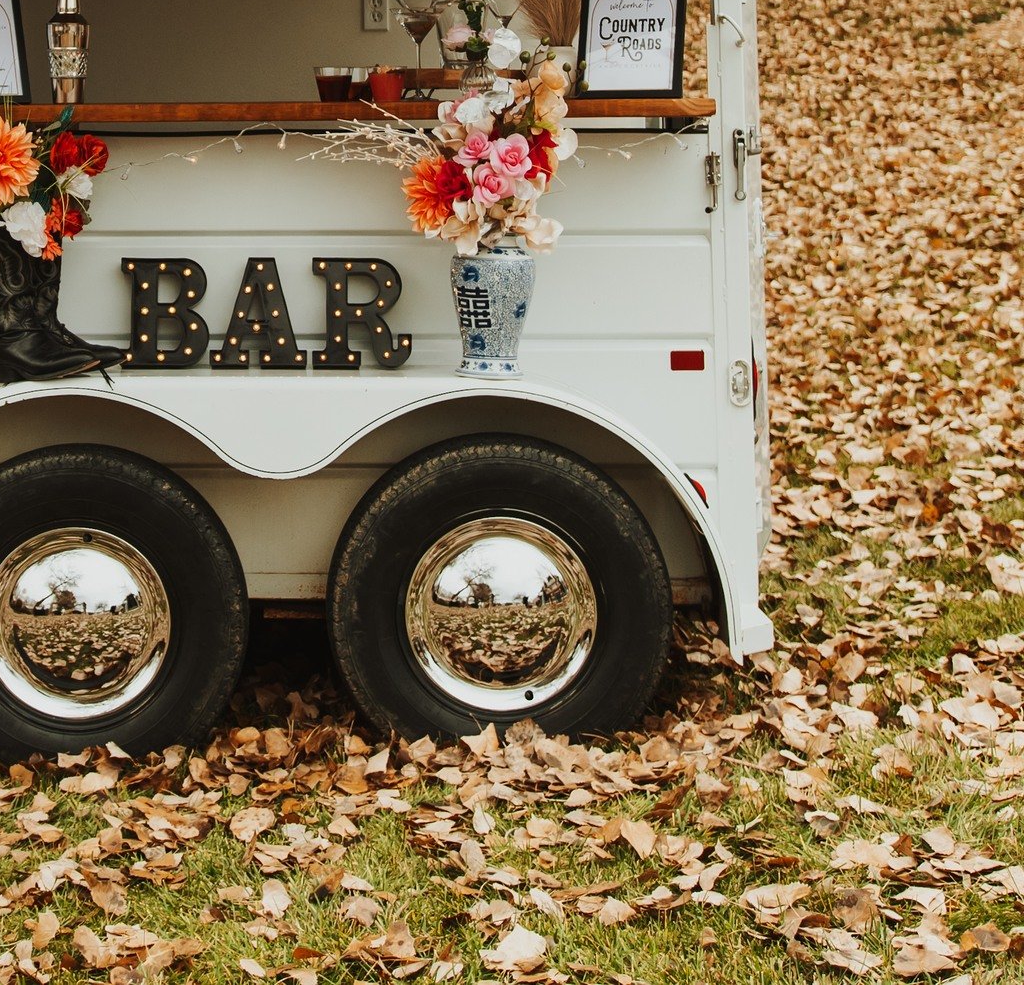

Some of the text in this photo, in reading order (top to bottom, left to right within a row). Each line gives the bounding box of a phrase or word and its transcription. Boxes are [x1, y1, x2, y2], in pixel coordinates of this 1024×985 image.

[599, 16, 666, 41] COUNTRY
[617, 35, 662, 62] ROADS
[121, 257, 412, 370] BAR
